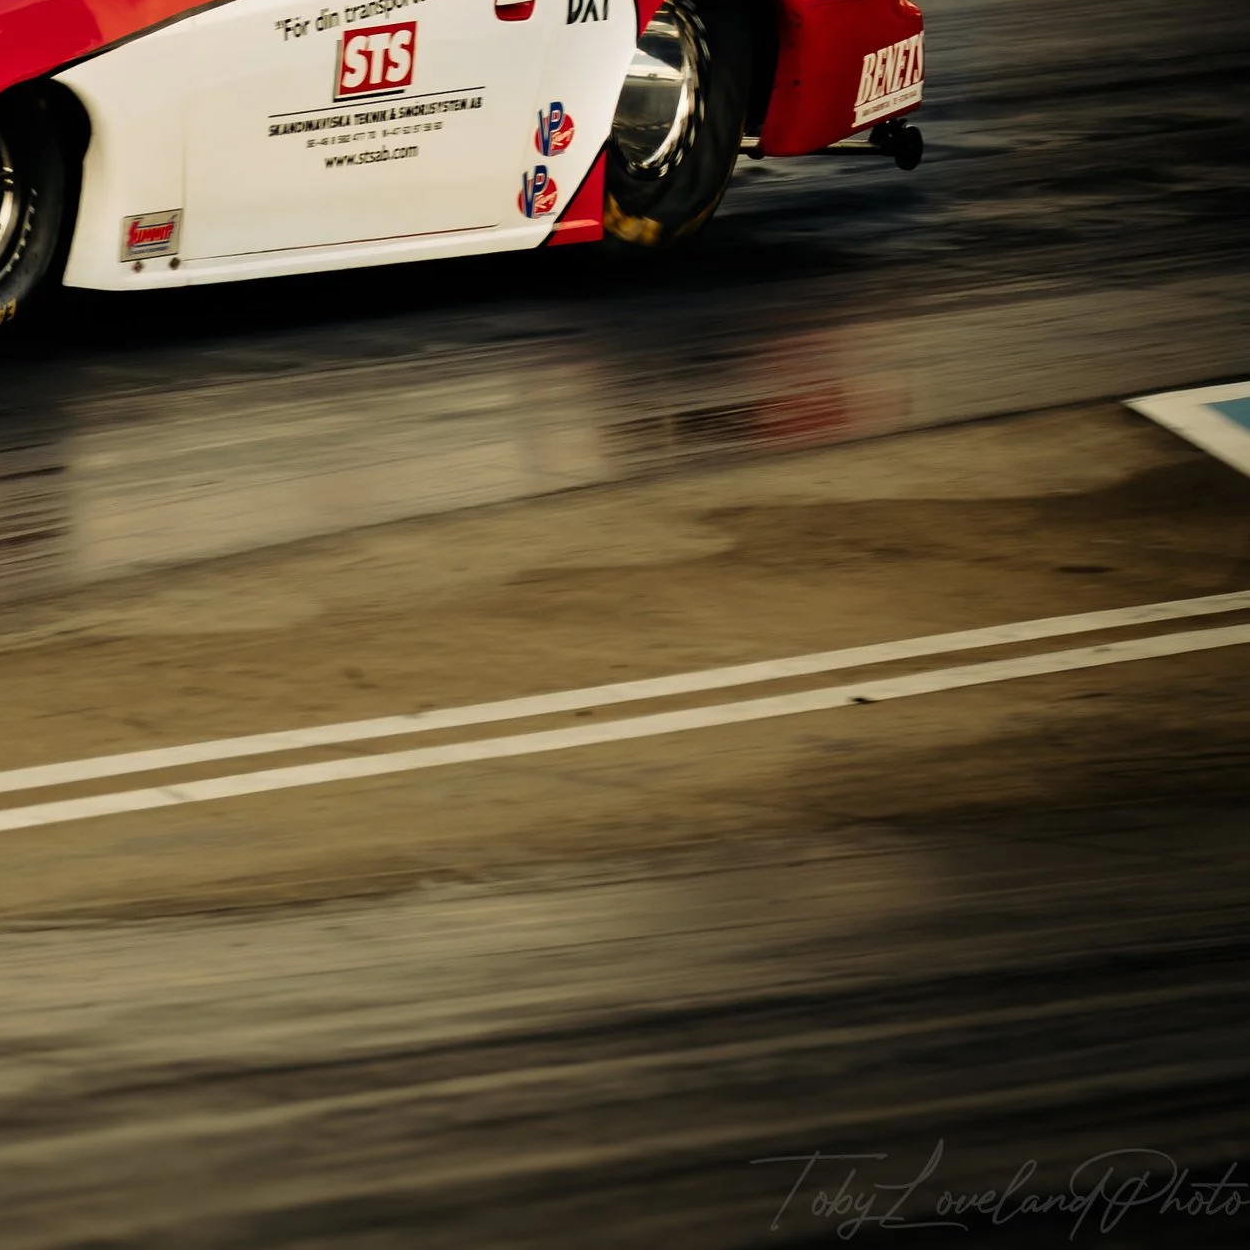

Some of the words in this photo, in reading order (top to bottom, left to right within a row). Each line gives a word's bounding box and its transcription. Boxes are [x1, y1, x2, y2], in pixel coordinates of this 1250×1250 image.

[315, 8, 339, 32] din
[340, 28, 412, 89] STS
[324, 145, 419, 169] www.stsab.com
